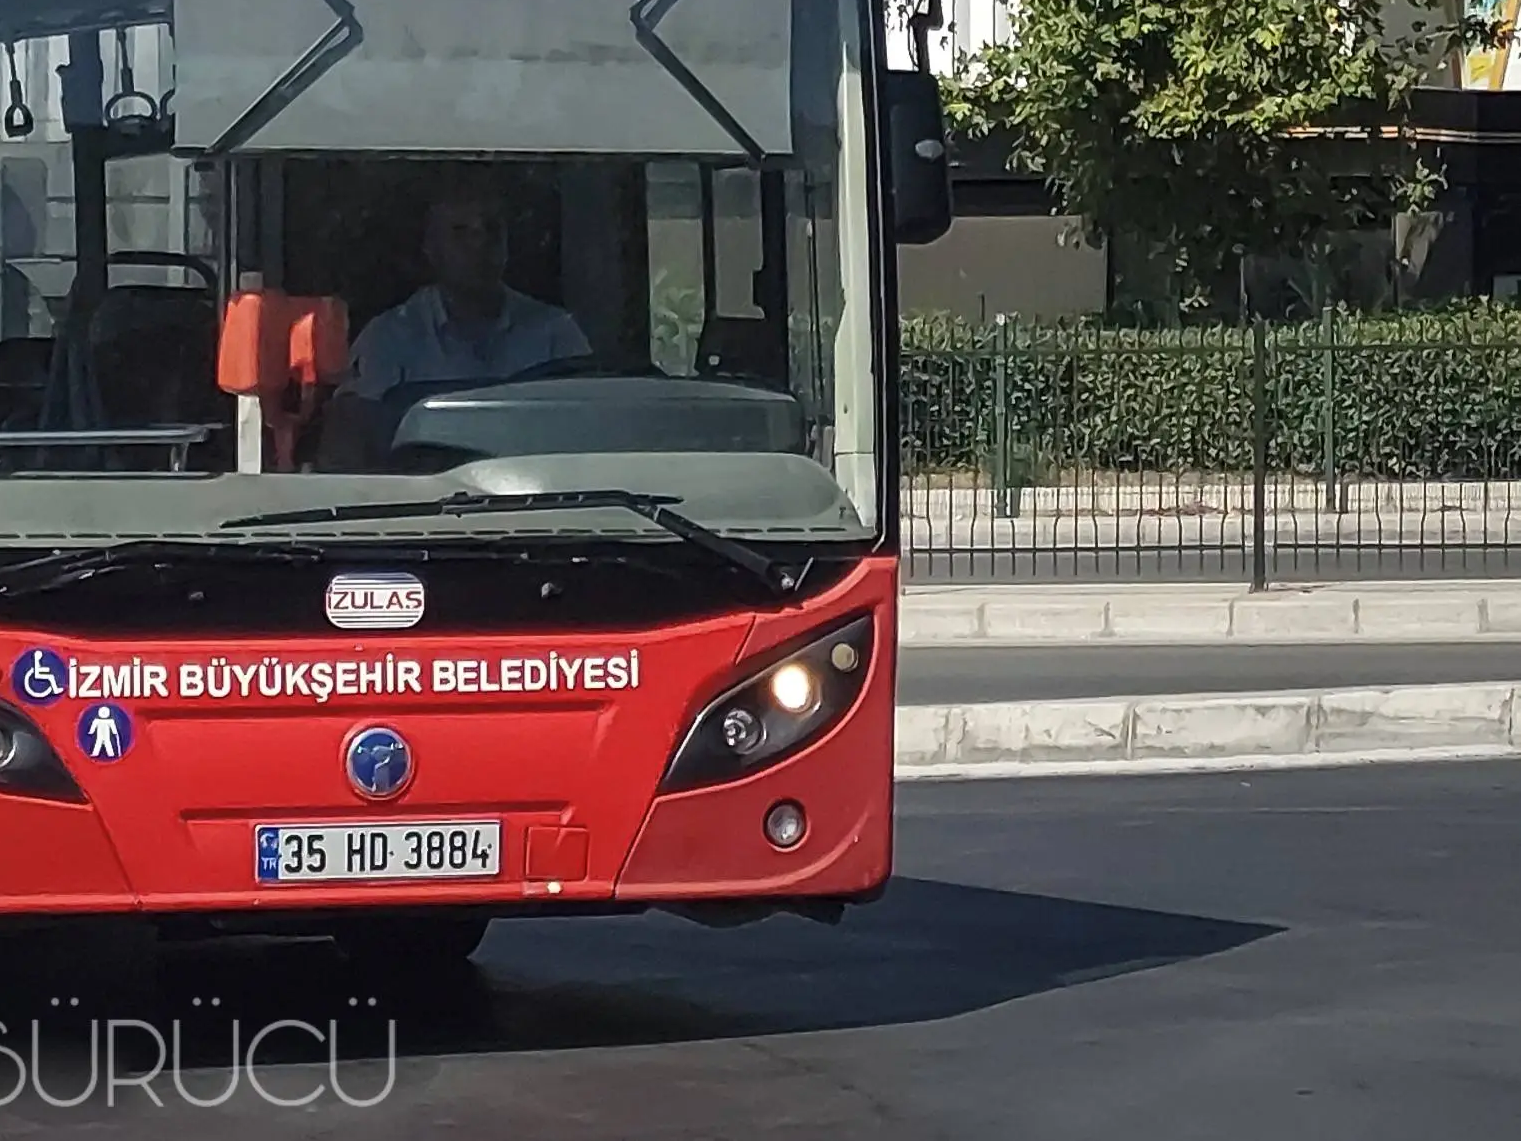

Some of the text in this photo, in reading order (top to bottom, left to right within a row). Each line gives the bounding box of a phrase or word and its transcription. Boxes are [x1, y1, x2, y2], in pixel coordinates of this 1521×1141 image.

[68, 648, 640, 704] İZMİR BÜYÜKŞEHİR BELEDİYESİ
[261, 856, 277, 870] TR
[284, 829, 490, 873] 35 HD 3884
